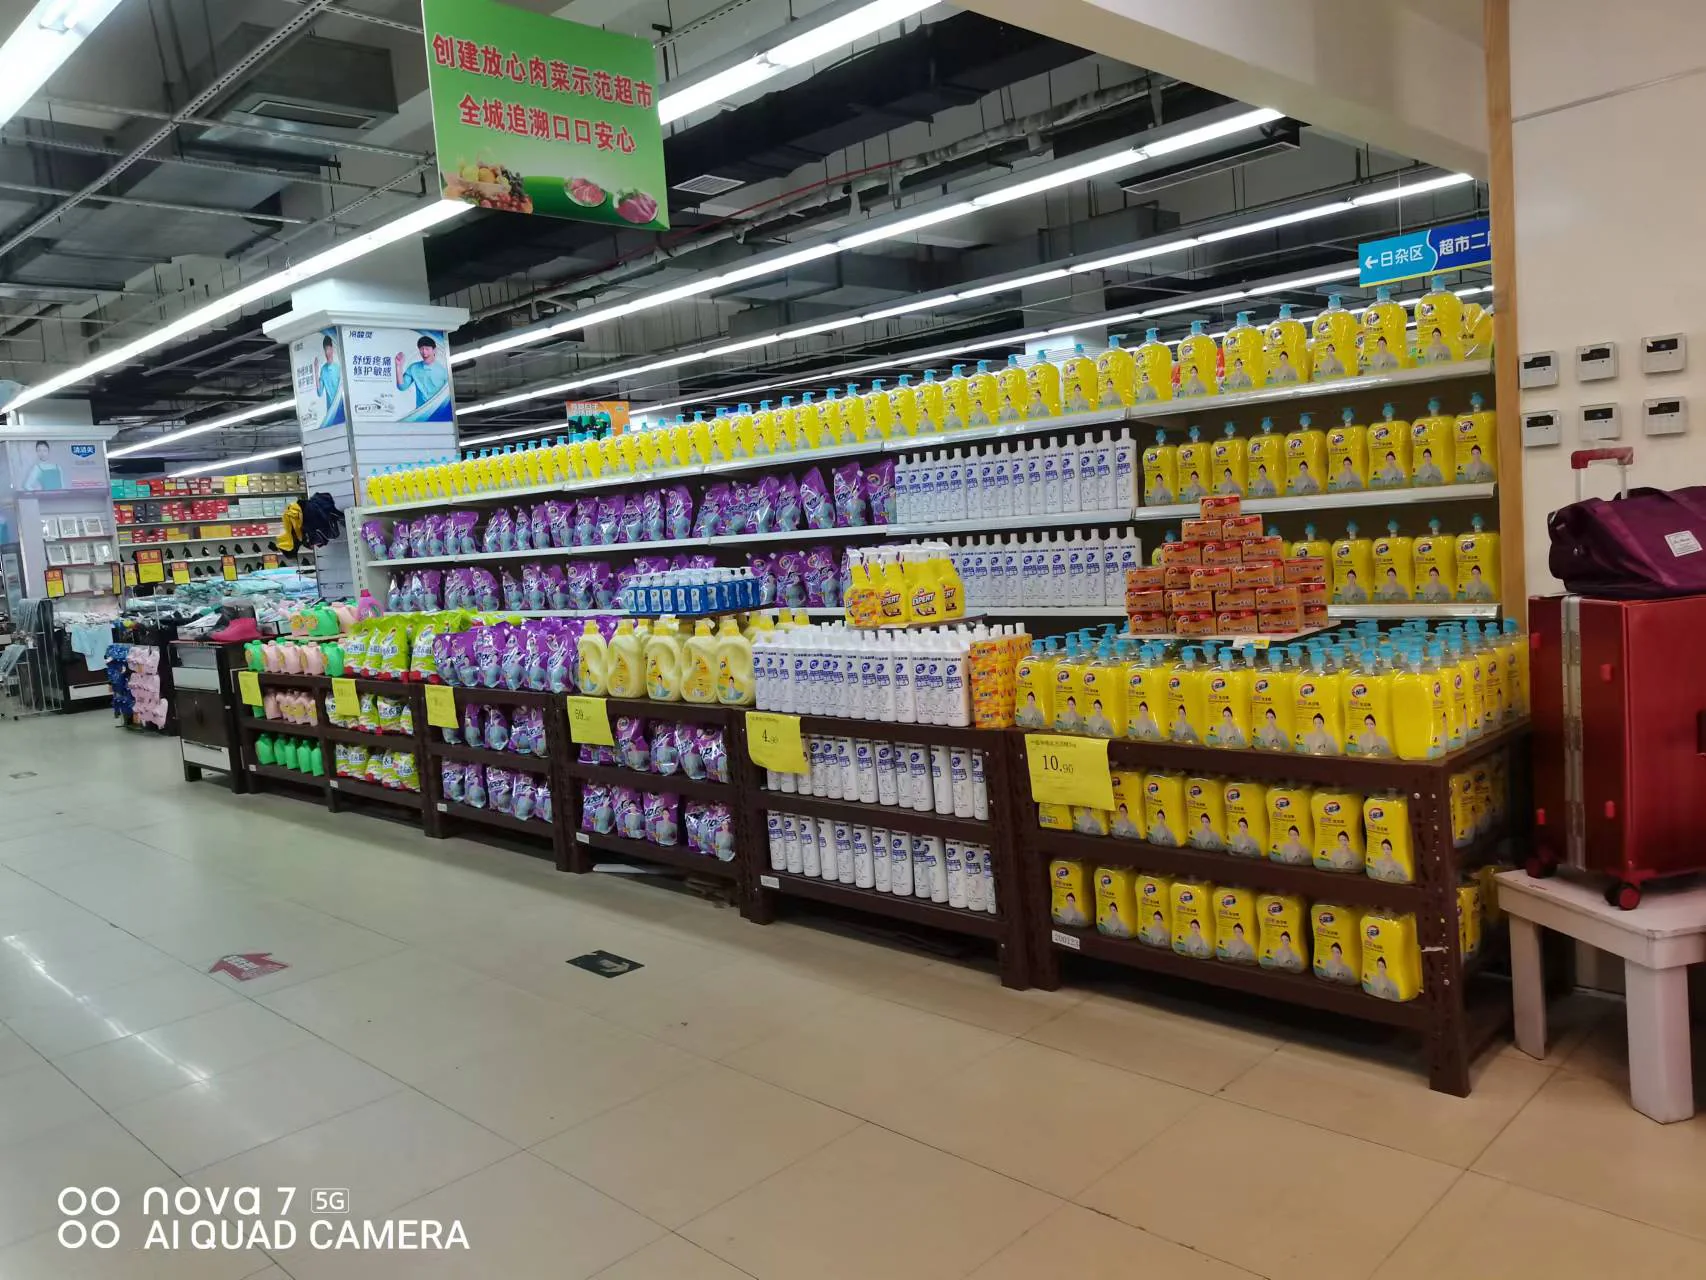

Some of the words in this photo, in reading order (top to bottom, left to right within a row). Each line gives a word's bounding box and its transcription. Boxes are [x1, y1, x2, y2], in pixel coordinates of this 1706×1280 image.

[432, 34, 654, 110] 创建放心肉菜示范超市
[458, 94, 636, 154] 全城追溯口口安心
[1439, 230, 1491, 257] 超市二
[1381, 244, 1424, 267] 日杂区
[352, 355, 392, 366] 舒缓疼痛
[353, 366, 392, 377] 修护敏感
[1041, 754, 1073, 774] 10.90
